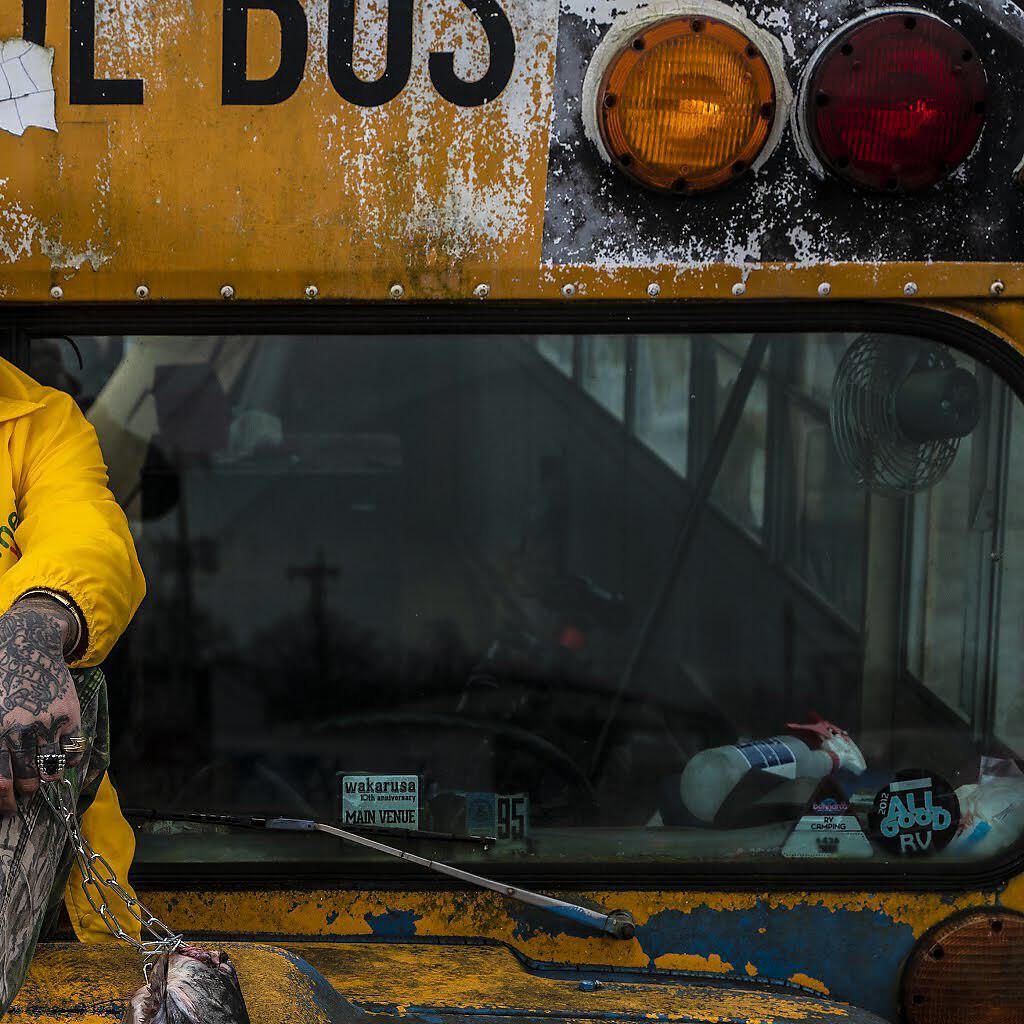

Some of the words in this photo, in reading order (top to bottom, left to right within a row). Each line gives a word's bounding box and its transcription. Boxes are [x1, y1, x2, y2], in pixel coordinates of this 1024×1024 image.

[345, 777, 416, 794] wakarusa
[360, 794, 375, 802] 10th
[886, 790, 935, 816] ALL
[345, 810, 375, 824] MAIN
[379, 810, 416, 824] VENUE
[497, 798, 525, 839] 95
[880, 806, 952, 838] GOOD
[900, 831, 933, 853] RV
